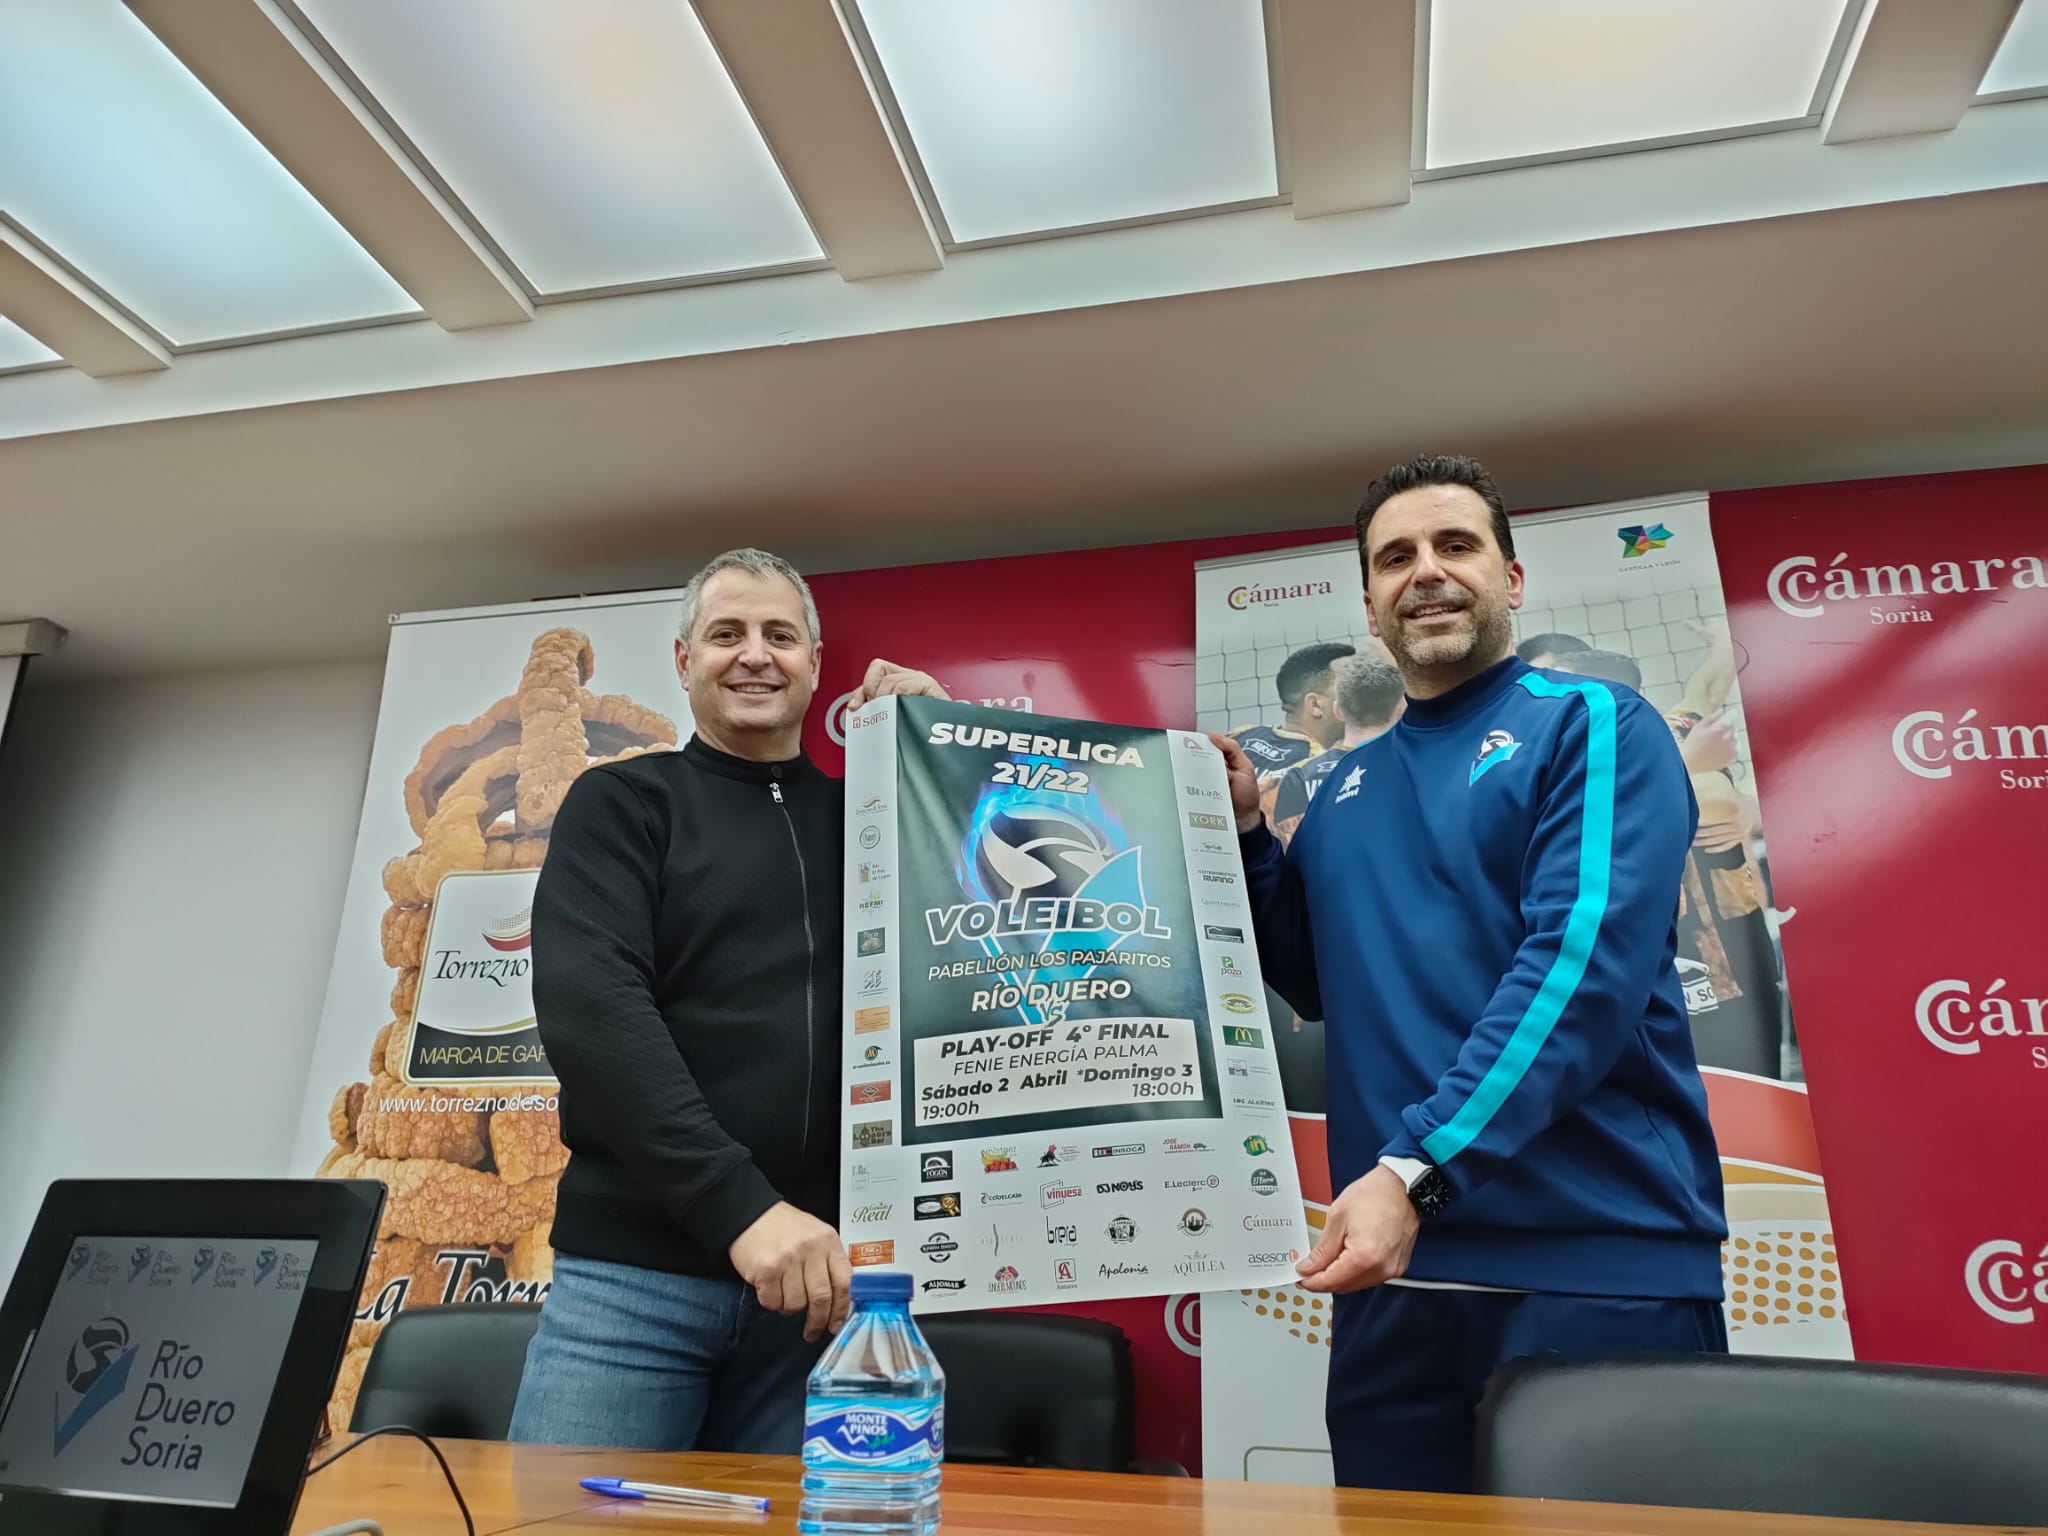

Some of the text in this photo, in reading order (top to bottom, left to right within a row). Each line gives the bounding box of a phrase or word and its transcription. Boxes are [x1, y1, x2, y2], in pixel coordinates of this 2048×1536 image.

[1619, 564, 1653, 573] CASTILLA
[1227, 580, 1333, 611] Cámara
[1767, 551, 2048, 618] Cámara
[1869, 605, 1933, 625] Soria
[928, 722, 1144, 768] SUPERLIGA
[991, 761, 1089, 794] 21/22
[1191, 814, 1225, 827] YORK
[925, 896, 1172, 945] VOLEIBOL
[432, 950, 529, 987] Torrezno
[928, 949, 1172, 981] PABELLÓN LOS PAJARITOS
[971, 978, 1132, 1013] RÍO DUERO
[1041, 1000, 1067, 1026] VS
[941, 1027, 1053, 1058] PLAY-OFF
[1098, 1023, 1170, 1040] FINAL
[419, 1047, 483, 1065] MARCA
[486, 1046, 509, 1063] DE
[954, 1045, 1158, 1076] FENIE ENERGÍA PALMA
[922, 1077, 993, 1101] Sábado
[998, 1078, 1009, 1092] 2
[1020, 1069, 1068, 1090] Abril
[1181, 1063, 1193, 1077] 3
[1132, 1082, 1194, 1098] 18:00h
[922, 1101, 979, 1120] 19:00h
[1112, 1146, 1143, 1154] INSOCA
[1046, 1187, 1082, 1200] vinuesa
[1096, 1183, 1111, 1194] DJ
[1164, 1178, 1206, 1189] E.Leclerc
[1243, 1215, 1293, 1231] Cámara
[1099, 1262, 1149, 1279] Apolonia
[1173, 1261, 1226, 1276] AQUILEA
[150, 1340, 204, 1380] Río
[135, 1382, 235, 1427] Duero
[845, 1413, 888, 1425] MONTE
[850, 1423, 888, 1436] PINOS
[121, 1426, 203, 1471] Soria
